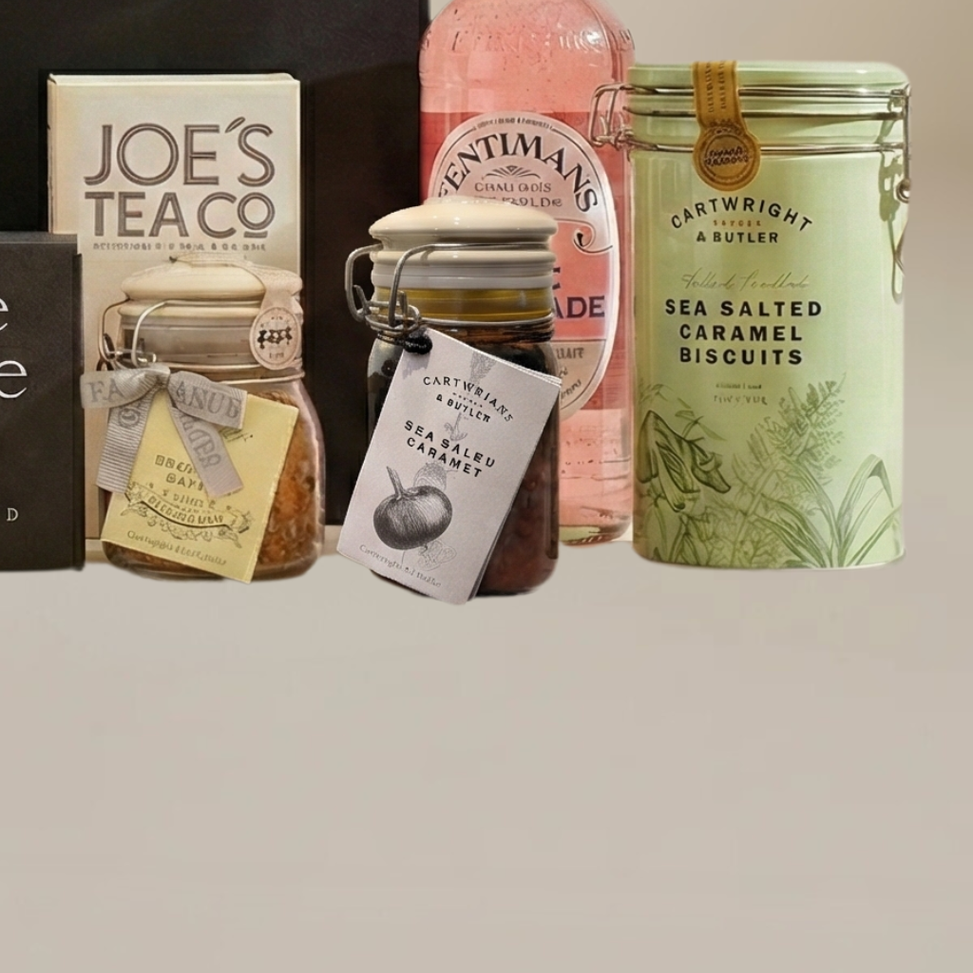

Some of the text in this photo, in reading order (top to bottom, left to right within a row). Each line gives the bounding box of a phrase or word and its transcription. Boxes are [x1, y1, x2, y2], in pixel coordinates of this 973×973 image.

[671, 196, 812, 232] CARTWRIGHT
[713, 231, 779, 244] BUTLER
[665, 299, 822, 317] SEA SALTED
[679, 324, 803, 341] CARAMEL
[679, 347, 803, 365] BISCUITS
[404, 420, 434, 442] SEA
